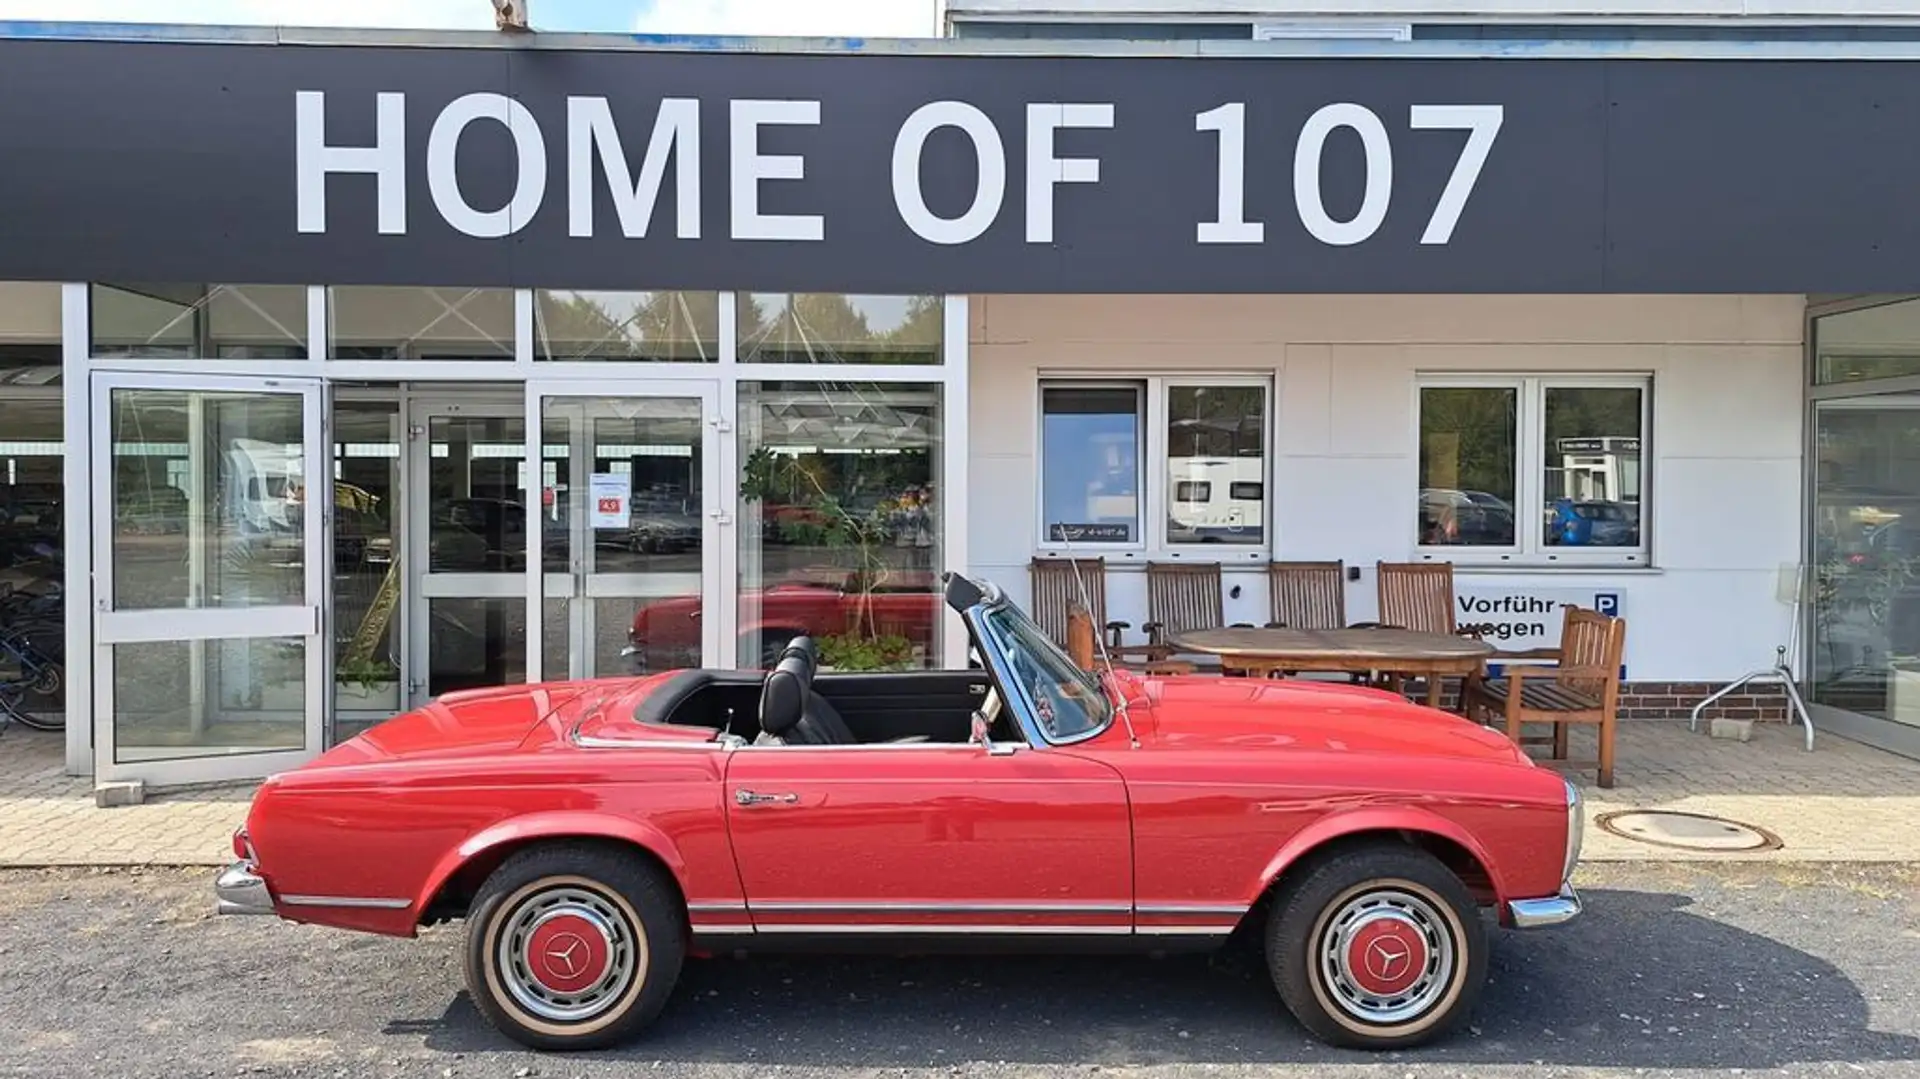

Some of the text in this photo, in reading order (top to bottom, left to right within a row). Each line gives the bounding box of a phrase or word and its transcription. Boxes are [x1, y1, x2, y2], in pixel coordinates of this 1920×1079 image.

[295, 90, 1504, 245] HOME OF 107
